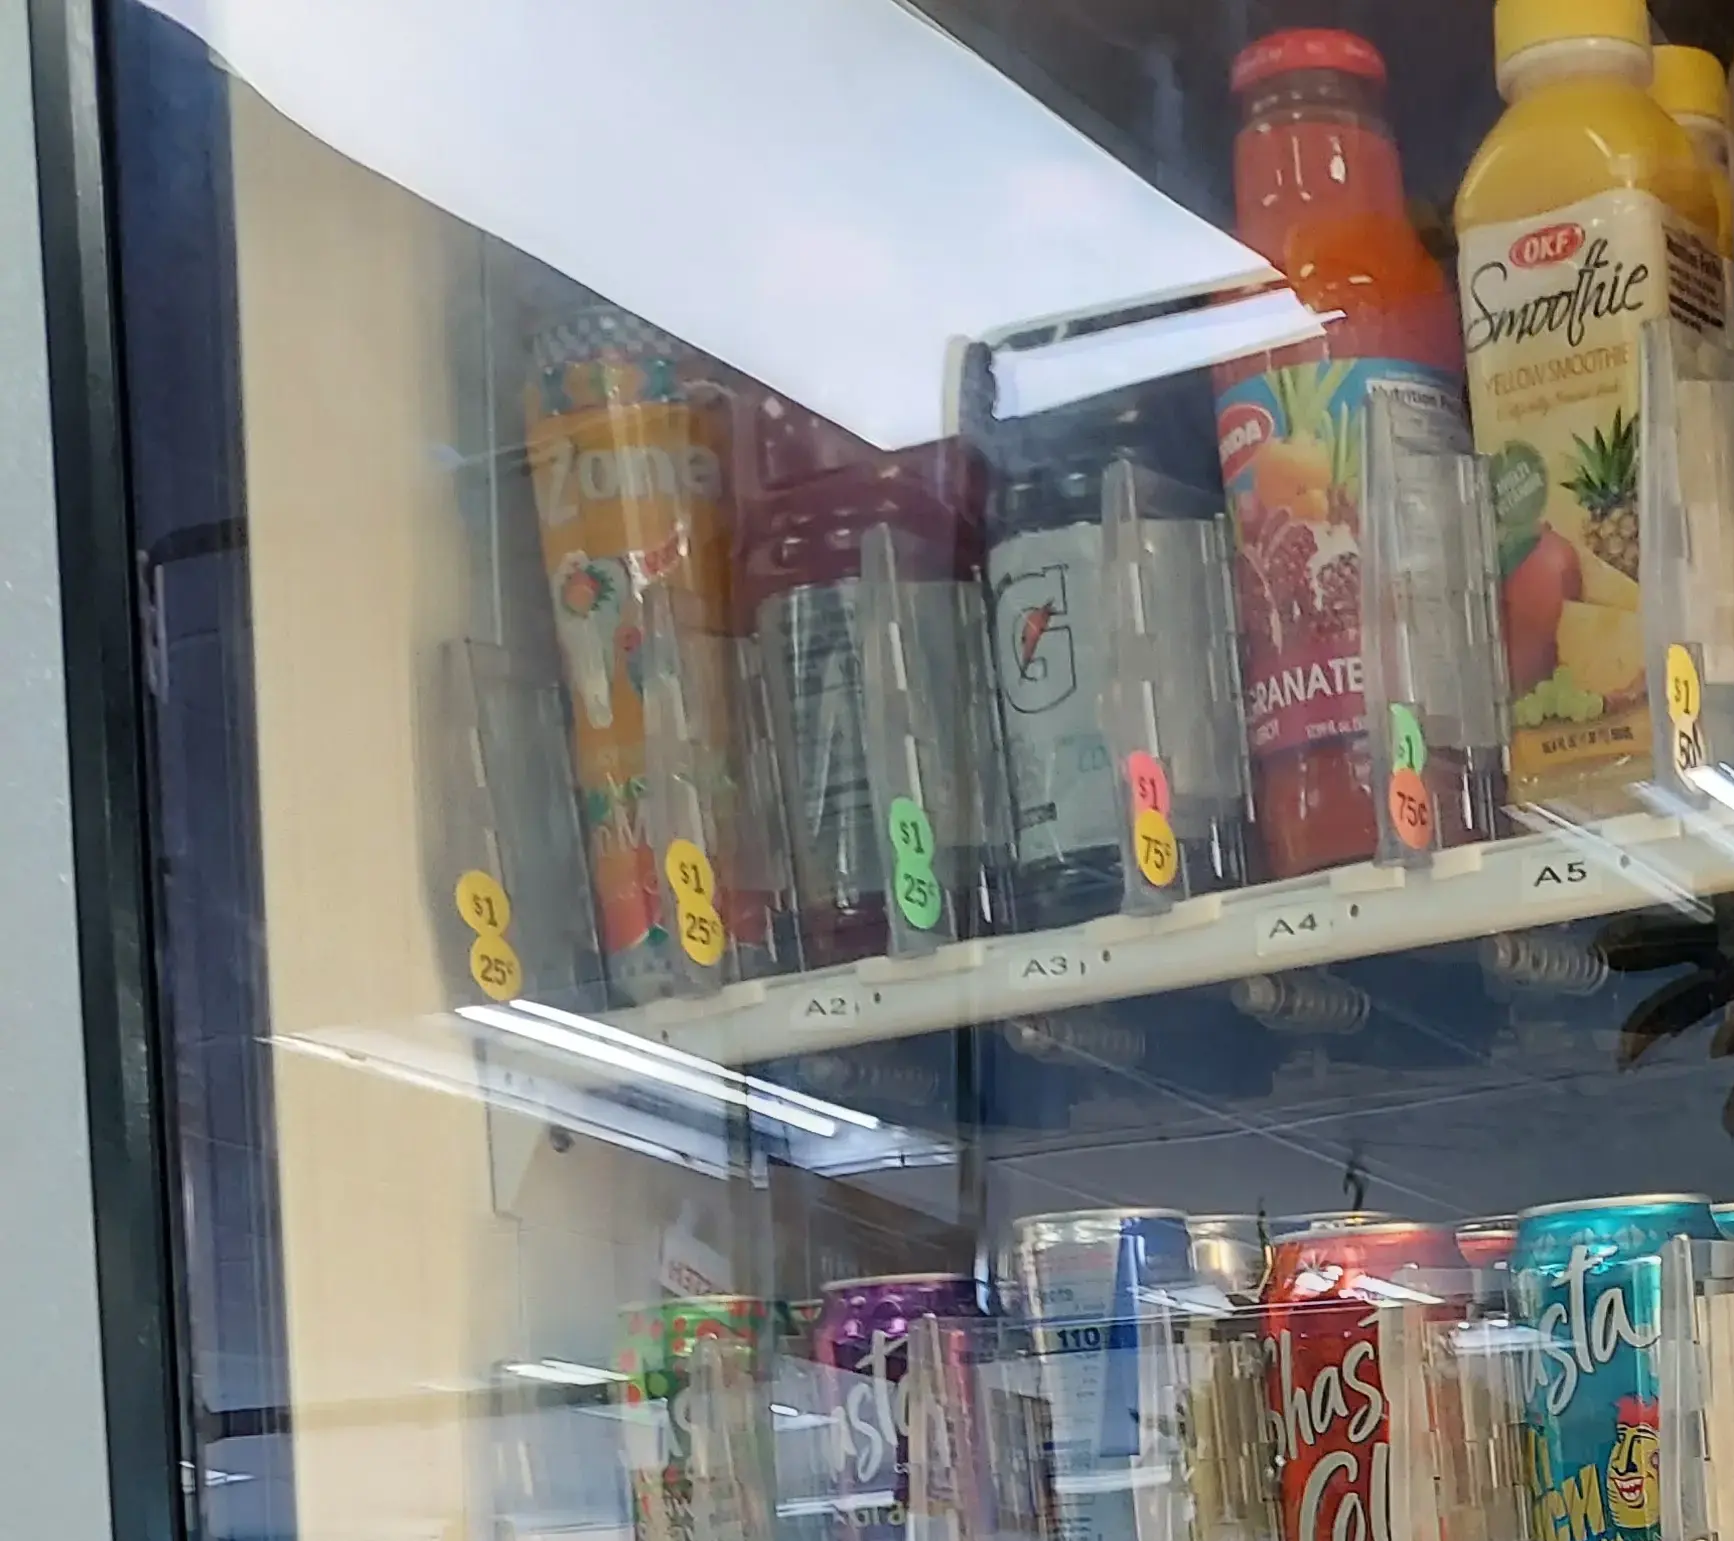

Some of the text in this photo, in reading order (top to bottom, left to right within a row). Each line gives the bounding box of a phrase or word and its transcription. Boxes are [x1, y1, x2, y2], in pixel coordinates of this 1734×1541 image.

[1522, 235, 1570, 264] OKF
[1466, 238, 1649, 354] Smoothie
[1534, 862, 1587, 887] A5
[1269, 914, 1316, 937] A4
[1022, 958, 1067, 977] A3
[805, 997, 847, 1017] A2
[1056, 1328, 1099, 1348] 110
